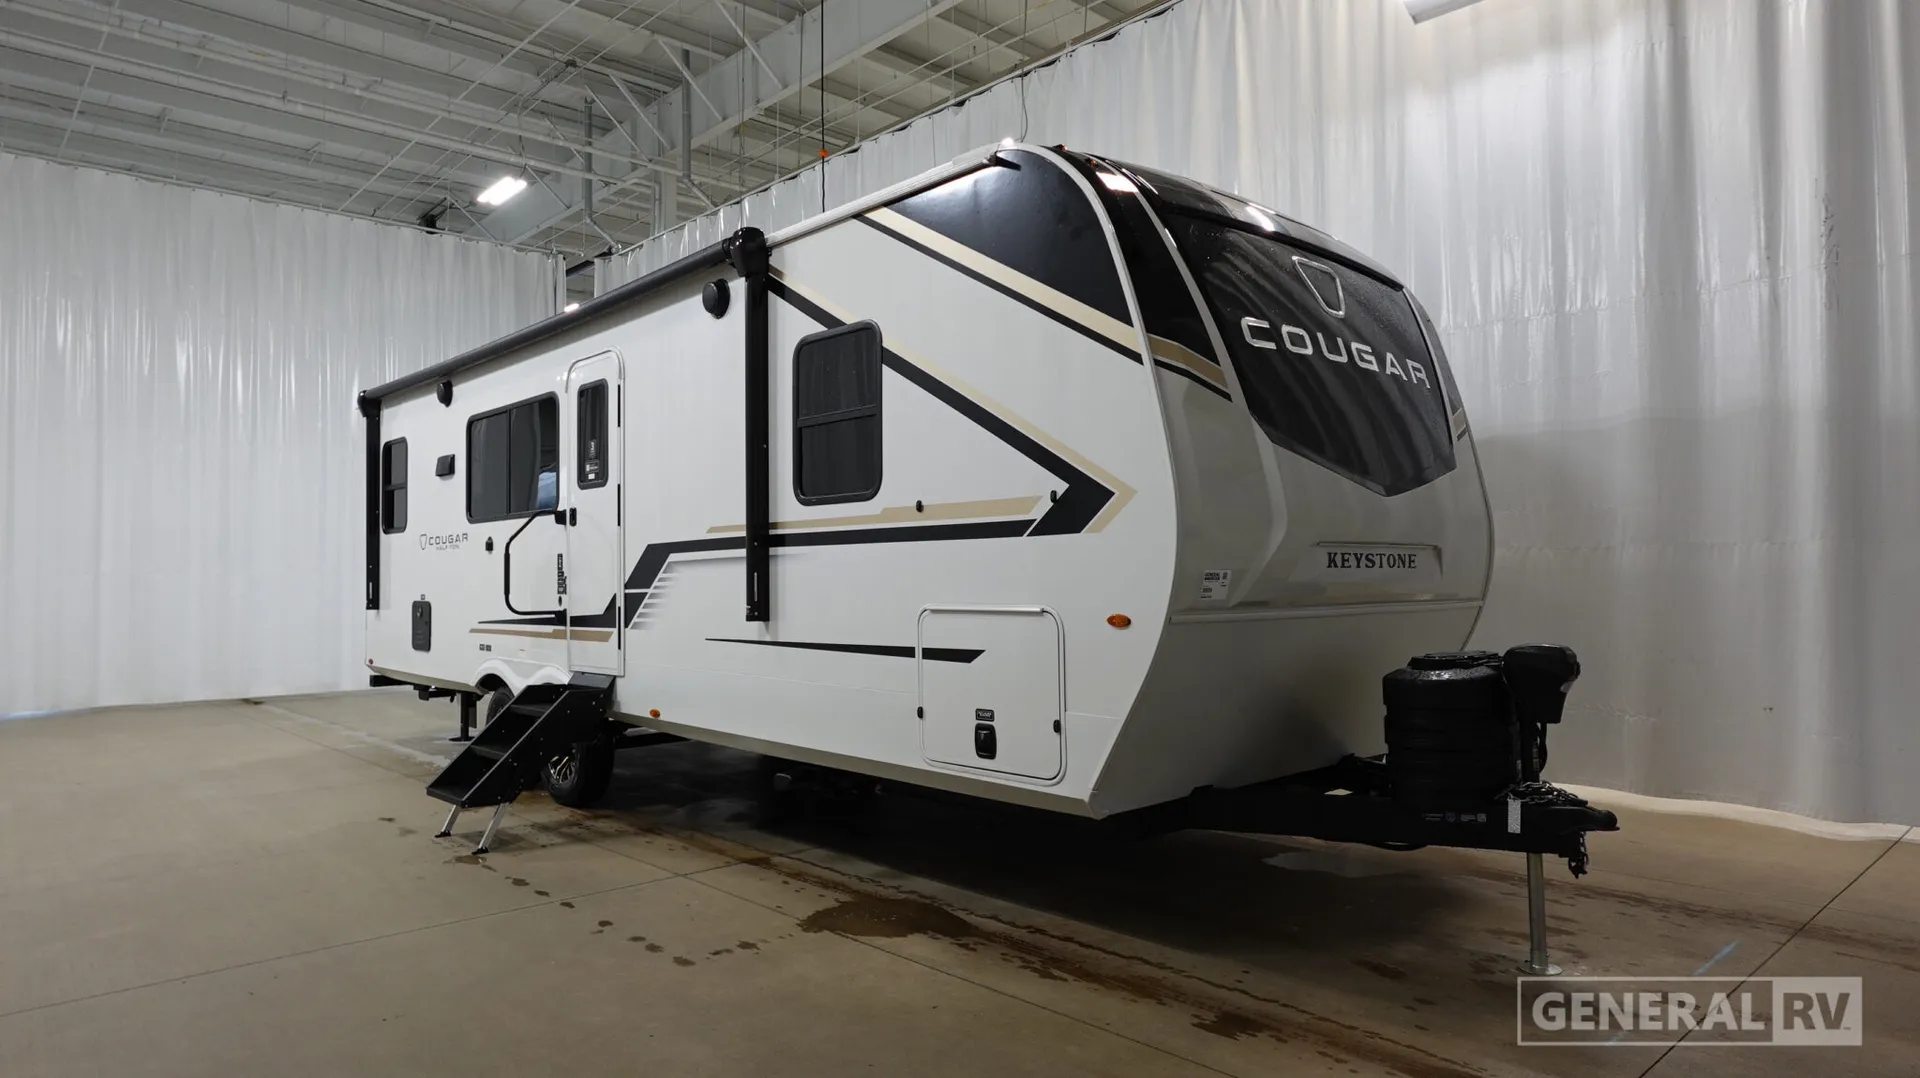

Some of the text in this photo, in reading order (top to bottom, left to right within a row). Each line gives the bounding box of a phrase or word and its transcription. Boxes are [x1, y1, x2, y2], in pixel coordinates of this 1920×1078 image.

[1241, 316, 1430, 389] COUGAR
[429, 533, 468, 545] COUGAR
[1326, 552, 1417, 569] KEYSTONE
